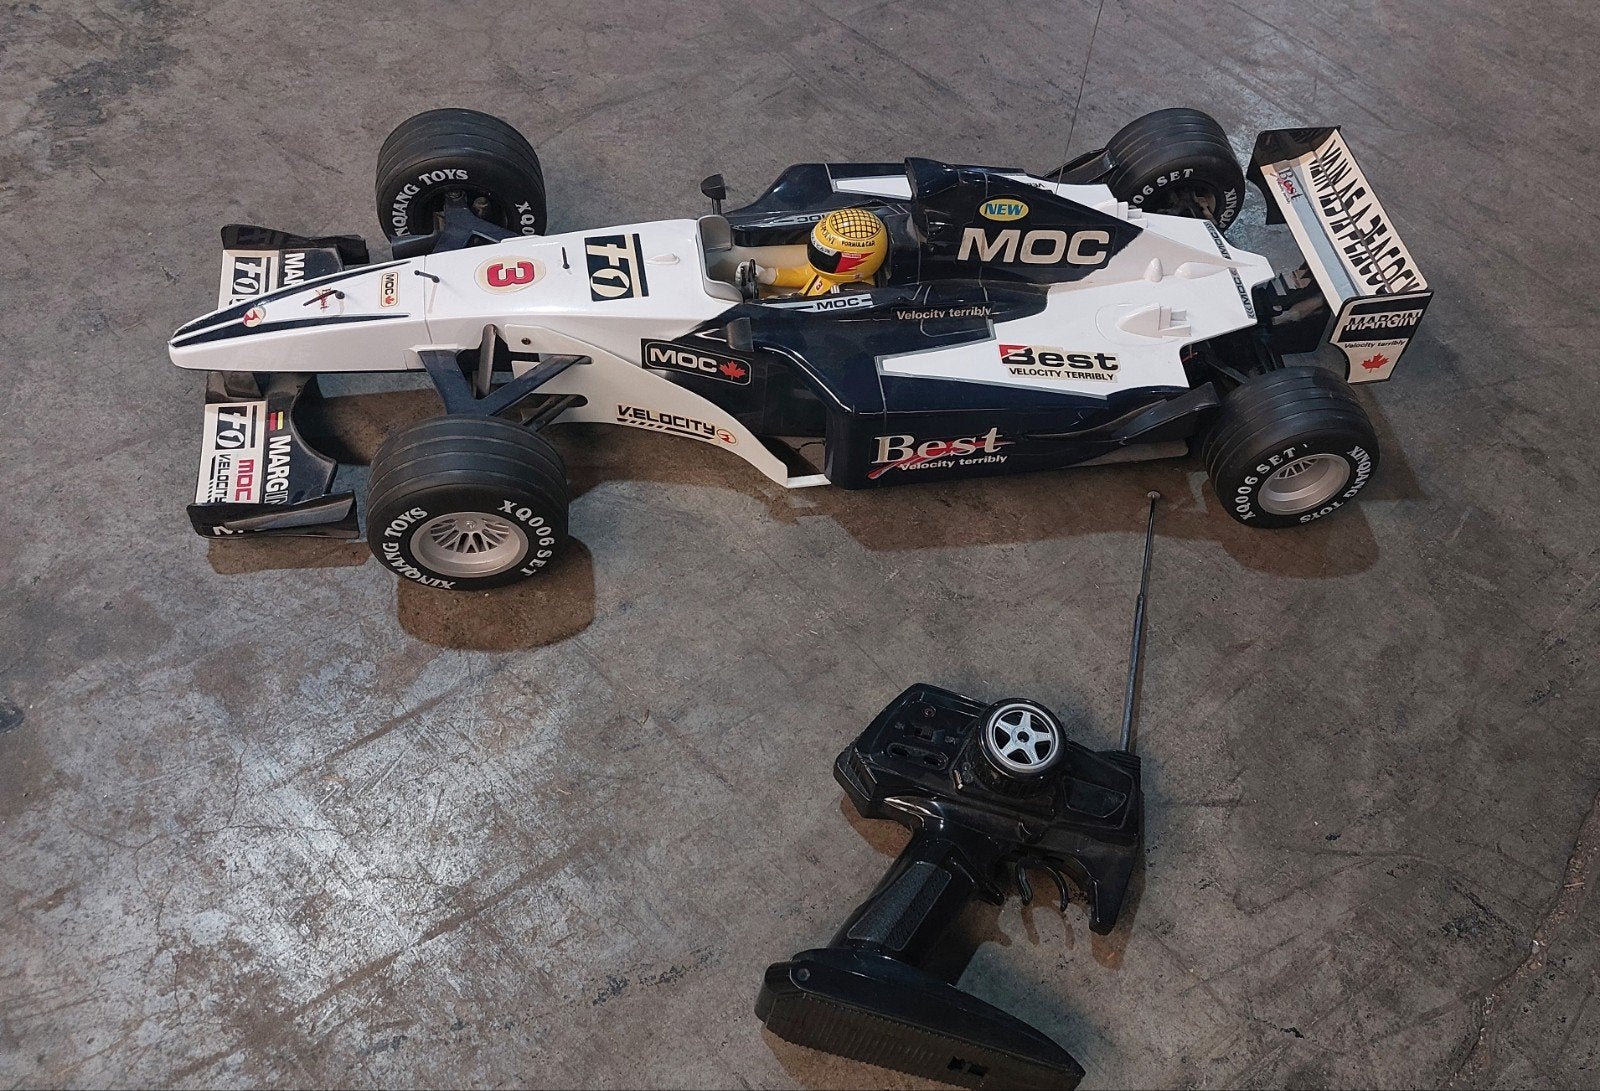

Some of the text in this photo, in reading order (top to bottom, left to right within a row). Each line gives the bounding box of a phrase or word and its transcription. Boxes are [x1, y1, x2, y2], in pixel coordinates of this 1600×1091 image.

[1156, 168, 1193, 187] SET
[392, 169, 468, 236] NQIANG TOYS
[984, 203, 1023, 217] NEW
[515, 201, 535, 235] XQ0
[957, 227, 1110, 265] MOC
[234, 261, 261, 294] F1
[486, 261, 535, 287] 3
[584, 236, 635, 301] F1
[384, 273, 395, 295] MOC
[817, 298, 860, 310] MOC
[1345, 311, 1420, 331] MARGIN
[650, 347, 719, 373] MOC
[999, 344, 1119, 371] Best
[1009, 367, 1114, 381] VELOCITY TERRIBLY
[216, 412, 246, 449] F1
[871, 427, 1003, 464] Best
[899, 455, 1008, 471] Velocity terribly
[1235, 447, 1296, 521] XQ006 SET
[384, 506, 428, 538] TOYS
[1300, 501, 1344, 523] TOYS
[497, 500, 555, 576] XQ006 SET
